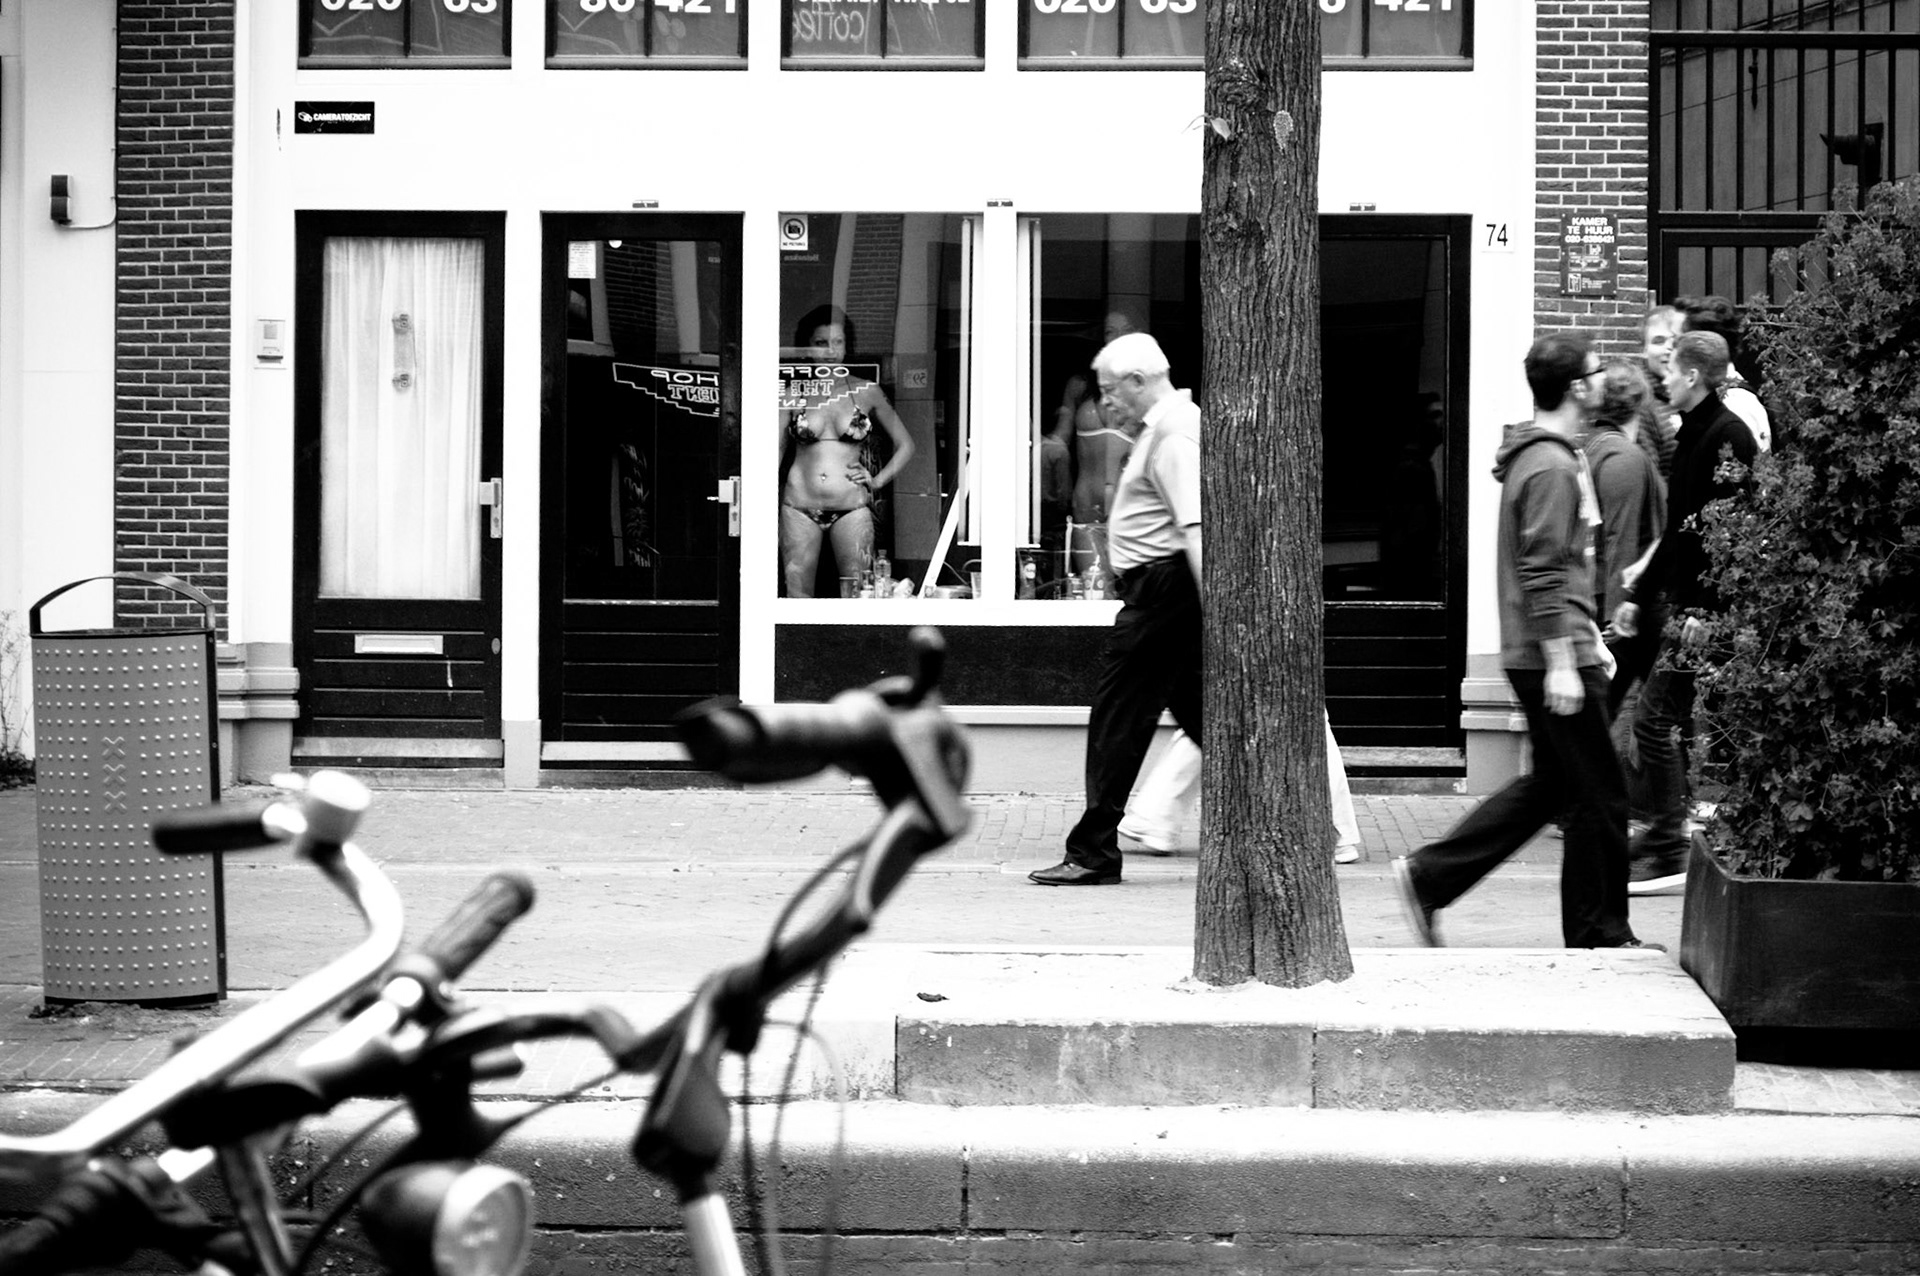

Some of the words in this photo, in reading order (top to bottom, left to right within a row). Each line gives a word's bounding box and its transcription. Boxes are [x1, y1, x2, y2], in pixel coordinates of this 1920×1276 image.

[1571, 217, 1608, 226] KAMER
[1486, 223, 1508, 246] 74
[1566, 225, 1580, 235] TE
[1584, 225, 1613, 235] HUUR
